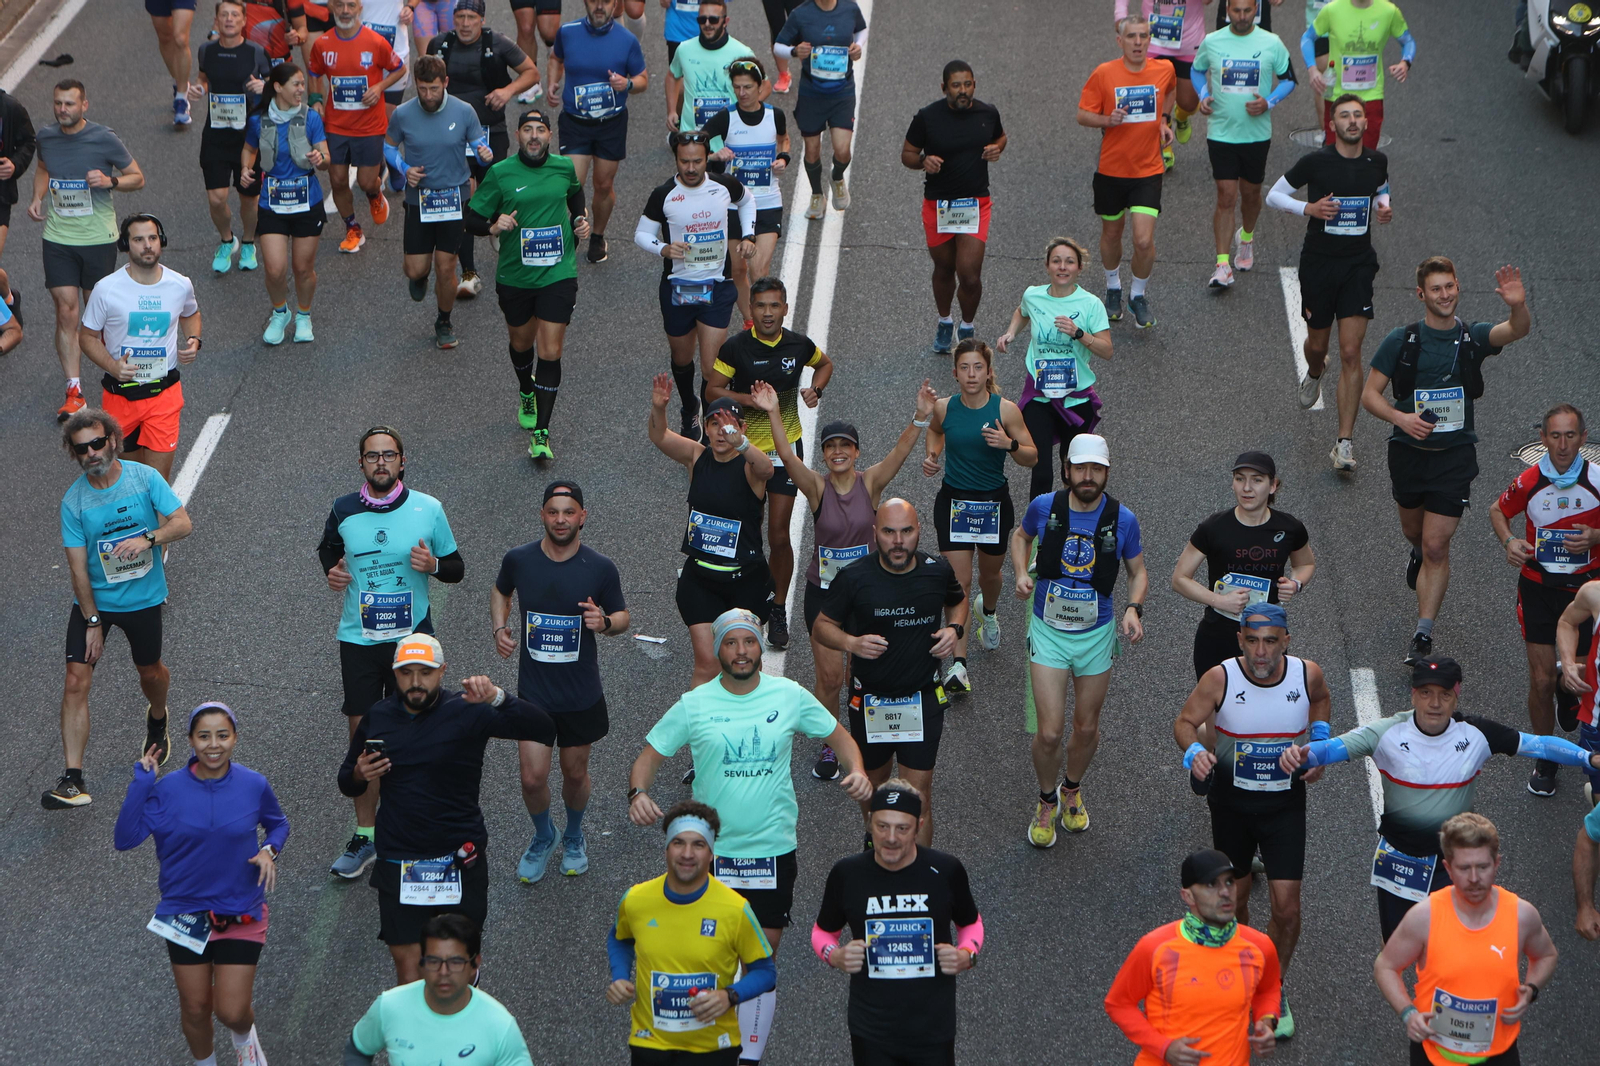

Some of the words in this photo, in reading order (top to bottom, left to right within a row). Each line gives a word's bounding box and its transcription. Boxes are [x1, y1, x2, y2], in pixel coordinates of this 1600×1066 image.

[1355, 57, 1374, 65] ZURICH
[692, 210, 712, 220] edp
[698, 233, 720, 241] ZURICH
[1432, 391, 1458, 400] ZURICH
[968, 503, 995, 511] ZURICH
[705, 519, 734, 530] ZURICH
[966, 516, 985, 526] 12917
[701, 532, 721, 543] 12727
[835, 549, 862, 559] ZURICH
[1235, 546, 1279, 561] SPORT
[115, 559, 146, 573] SPACEMAN
[1227, 563, 1283, 572] HACKNEY
[366, 571, 379, 579] SIETE
[379, 568, 396, 577] AGUAS
[1234, 576, 1263, 589] ZURICH
[377, 596, 405, 604] ZURICH
[1063, 591, 1092, 600] ZURICH
[1061, 605, 1079, 614] 9454
[375, 612, 397, 620] 12024
[1055, 613, 1085, 623] FRANÇOIS
[545, 618, 574, 626] ZURICH
[541, 633, 564, 642] 12189
[540, 644, 564, 652] STEFAN
[884, 712, 902, 721] 8817
[888, 723, 901, 731] KAY
[1256, 745, 1287, 755] ZURICH
[1252, 762, 1275, 771] 12244
[1255, 773, 1271, 781] TONI
[718, 867, 738, 876] DIOGO
[739, 868, 773, 877] FERREIRA
[1390, 861, 1414, 876] 12219
[420, 872, 444, 881] 12844
[866, 893, 929, 915] ALEX
[889, 922, 924, 932] ZURICH
[887, 942, 913, 953] 12453
[877, 955, 892, 964] RUN
[894, 955, 908, 964] ALE
[908, 955, 925, 963] RUN
[672, 976, 708, 987] ZURICH
[1454, 1001, 1489, 1011] ZURICH
[1449, 1017, 1475, 1030] 10515
